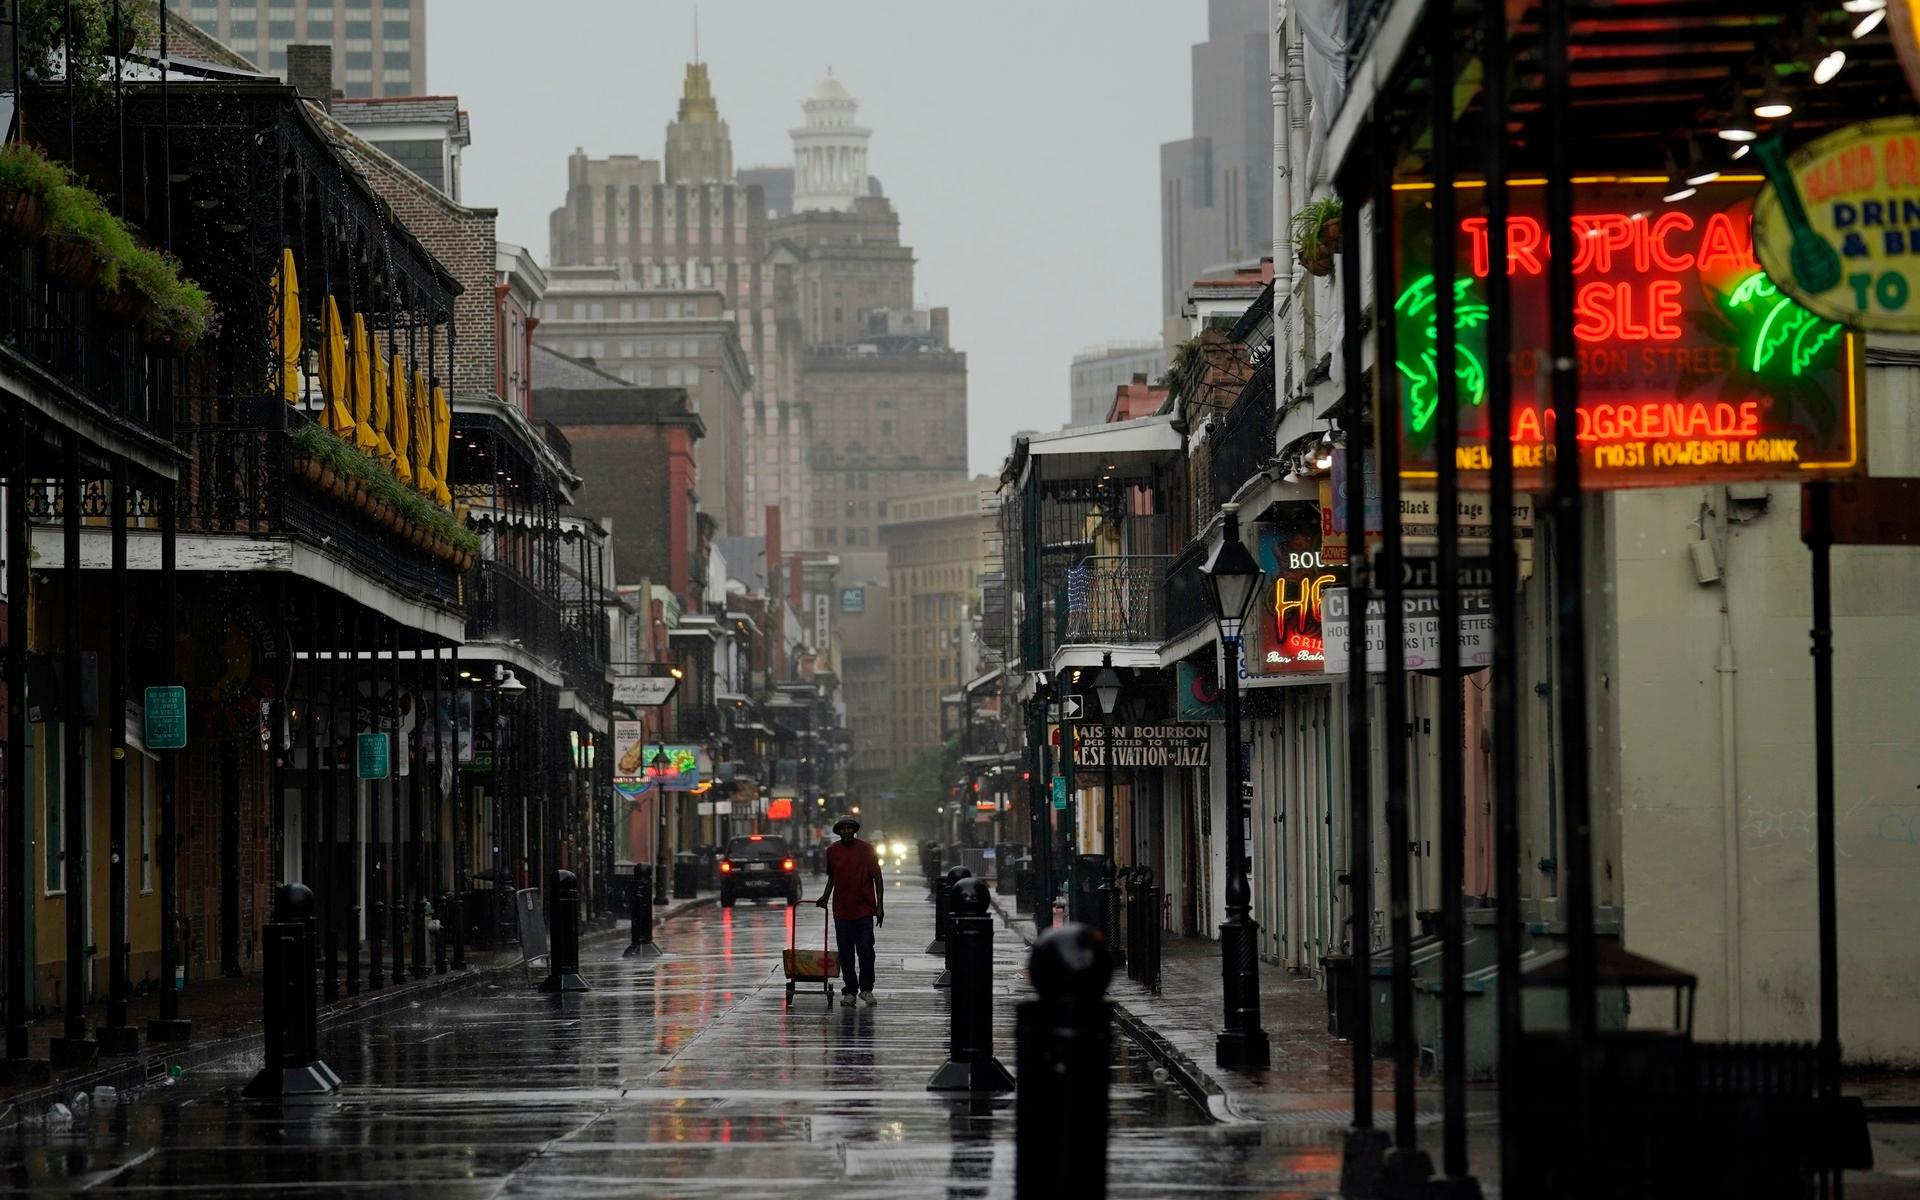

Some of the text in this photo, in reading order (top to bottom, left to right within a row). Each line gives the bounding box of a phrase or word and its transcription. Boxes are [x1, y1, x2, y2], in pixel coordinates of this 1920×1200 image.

[1843, 231, 1867, 257] &
[1849, 271, 1909, 311] TO
[1573, 280, 1682, 342] SLE
[1641, 348, 1740, 374] STREET
[1592, 401, 1758, 439] GRENADE
[1595, 442, 1646, 469] MOST
[1653, 440, 1742, 466] POWERFUL
[1746, 438, 1799, 464] DRINK
[1399, 500, 1429, 515] Black
[1266, 651, 1292, 664] Bar
[1133, 726, 1208, 738] BOURBON
[1174, 742, 1208, 766] JAZZ
